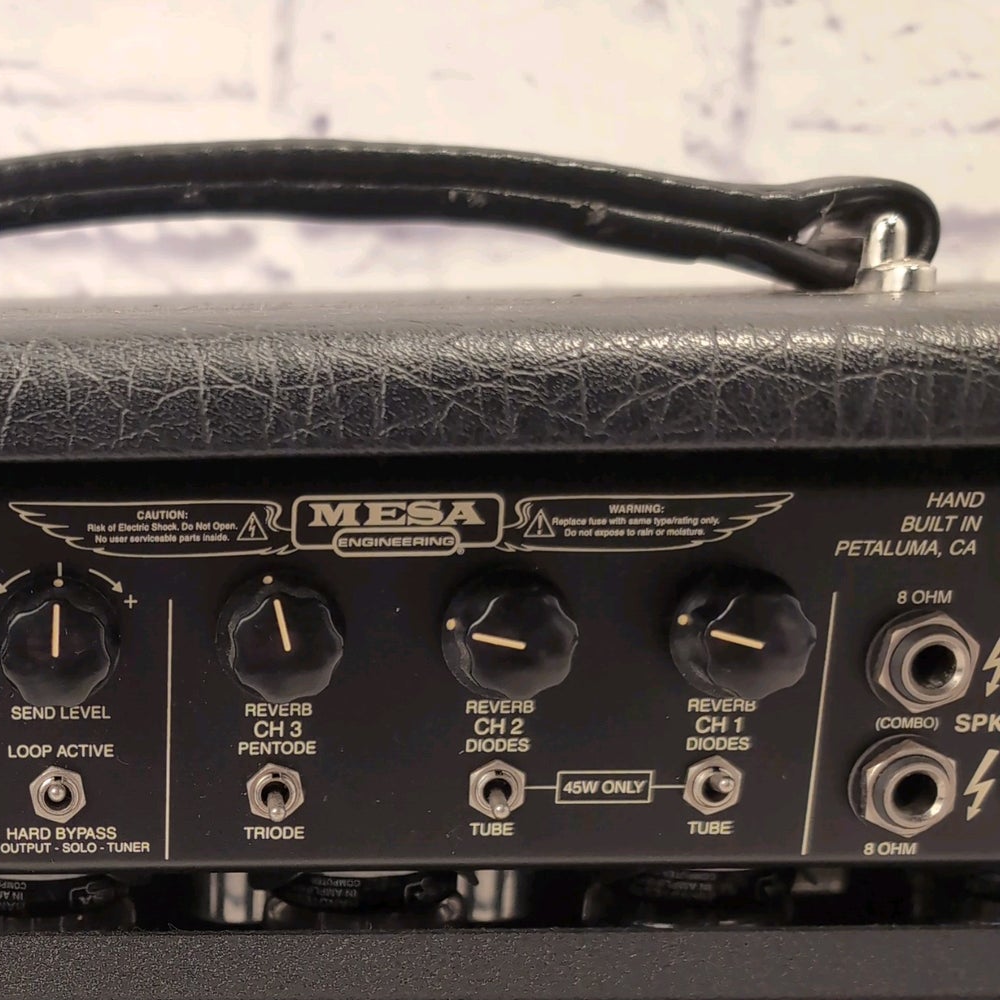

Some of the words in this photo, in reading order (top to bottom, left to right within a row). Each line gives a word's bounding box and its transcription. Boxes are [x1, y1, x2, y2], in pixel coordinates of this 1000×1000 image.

[927, 492, 985, 508] HAND
[137, 510, 188, 520] CAUTION:
[308, 501, 485, 527] MESA
[609, 504, 664, 513] WARNING:
[87, 524, 105, 532] Risk
[108, 523, 116, 532] of
[118, 523, 149, 532] Electric
[151, 523, 179, 532] Shock.
[181, 522, 193, 531] Do
[196, 522, 211, 531] Not
[213, 522, 238, 532] Open.
[552, 517, 587, 527] Replace
[589, 517, 607, 525] fuse
[609, 517, 626, 525] with
[653, 515, 699, 527] type/rating
[700, 516, 719, 526] only.
[901, 516, 957, 532] BUILT
[960, 516, 982, 531] IN
[95, 535, 107, 543] No
[130, 534, 177, 542] serviceable
[179, 534, 200, 543] parts
[203, 533, 229, 541] inside.
[564, 528, 577, 537] Do
[594, 529, 625, 537] expose
[637, 528, 654, 536] rain
[655, 528, 665, 536] or
[667, 526, 705, 536] moisture.
[338, 536, 455, 548] ENGINEERING
[835, 540, 941, 557] PETALUMA,
[950, 539, 976, 555] CA
[897, 590, 907, 604] 8
[912, 590, 952, 604] OHM
[245, 703, 312, 717] REVERB
[466, 700, 534, 714] REVERB
[688, 698, 756, 712] REVERB
[11, 706, 55, 720] SEND
[60, 706, 111, 719] LEVEL
[254, 720, 284, 738] CH
[290, 721, 302, 737] 3
[474, 717, 506, 735] CH
[510, 718, 524, 734] 2
[696, 716, 727, 733] CH
[734, 717, 742, 733] 1
[876, 717, 939, 731] (COMBO)
[238, 741, 316, 755] PENTODE
[465, 738, 530, 752] DIODES
[686, 737, 750, 750] DIODES
[8, 745, 52, 758] LOOP
[57, 744, 114, 757] ACTIVE
[563, 781, 599, 794] 45W
[602, 780, 646, 794] ONLY
[7, 827, 51, 840] HARD
[56, 827, 117, 840] BYPASS
[244, 826, 304, 839] TRIODE
[469, 822, 514, 836] TUBE
[687, 821, 732, 834] TUBE
[0, 843, 51, 853] OUTPUT
[63, 842, 97, 853] SOLO
[107, 842, 150, 853] TUNER
[864, 843, 875, 855] 8
[878, 842, 917, 855] OHM
